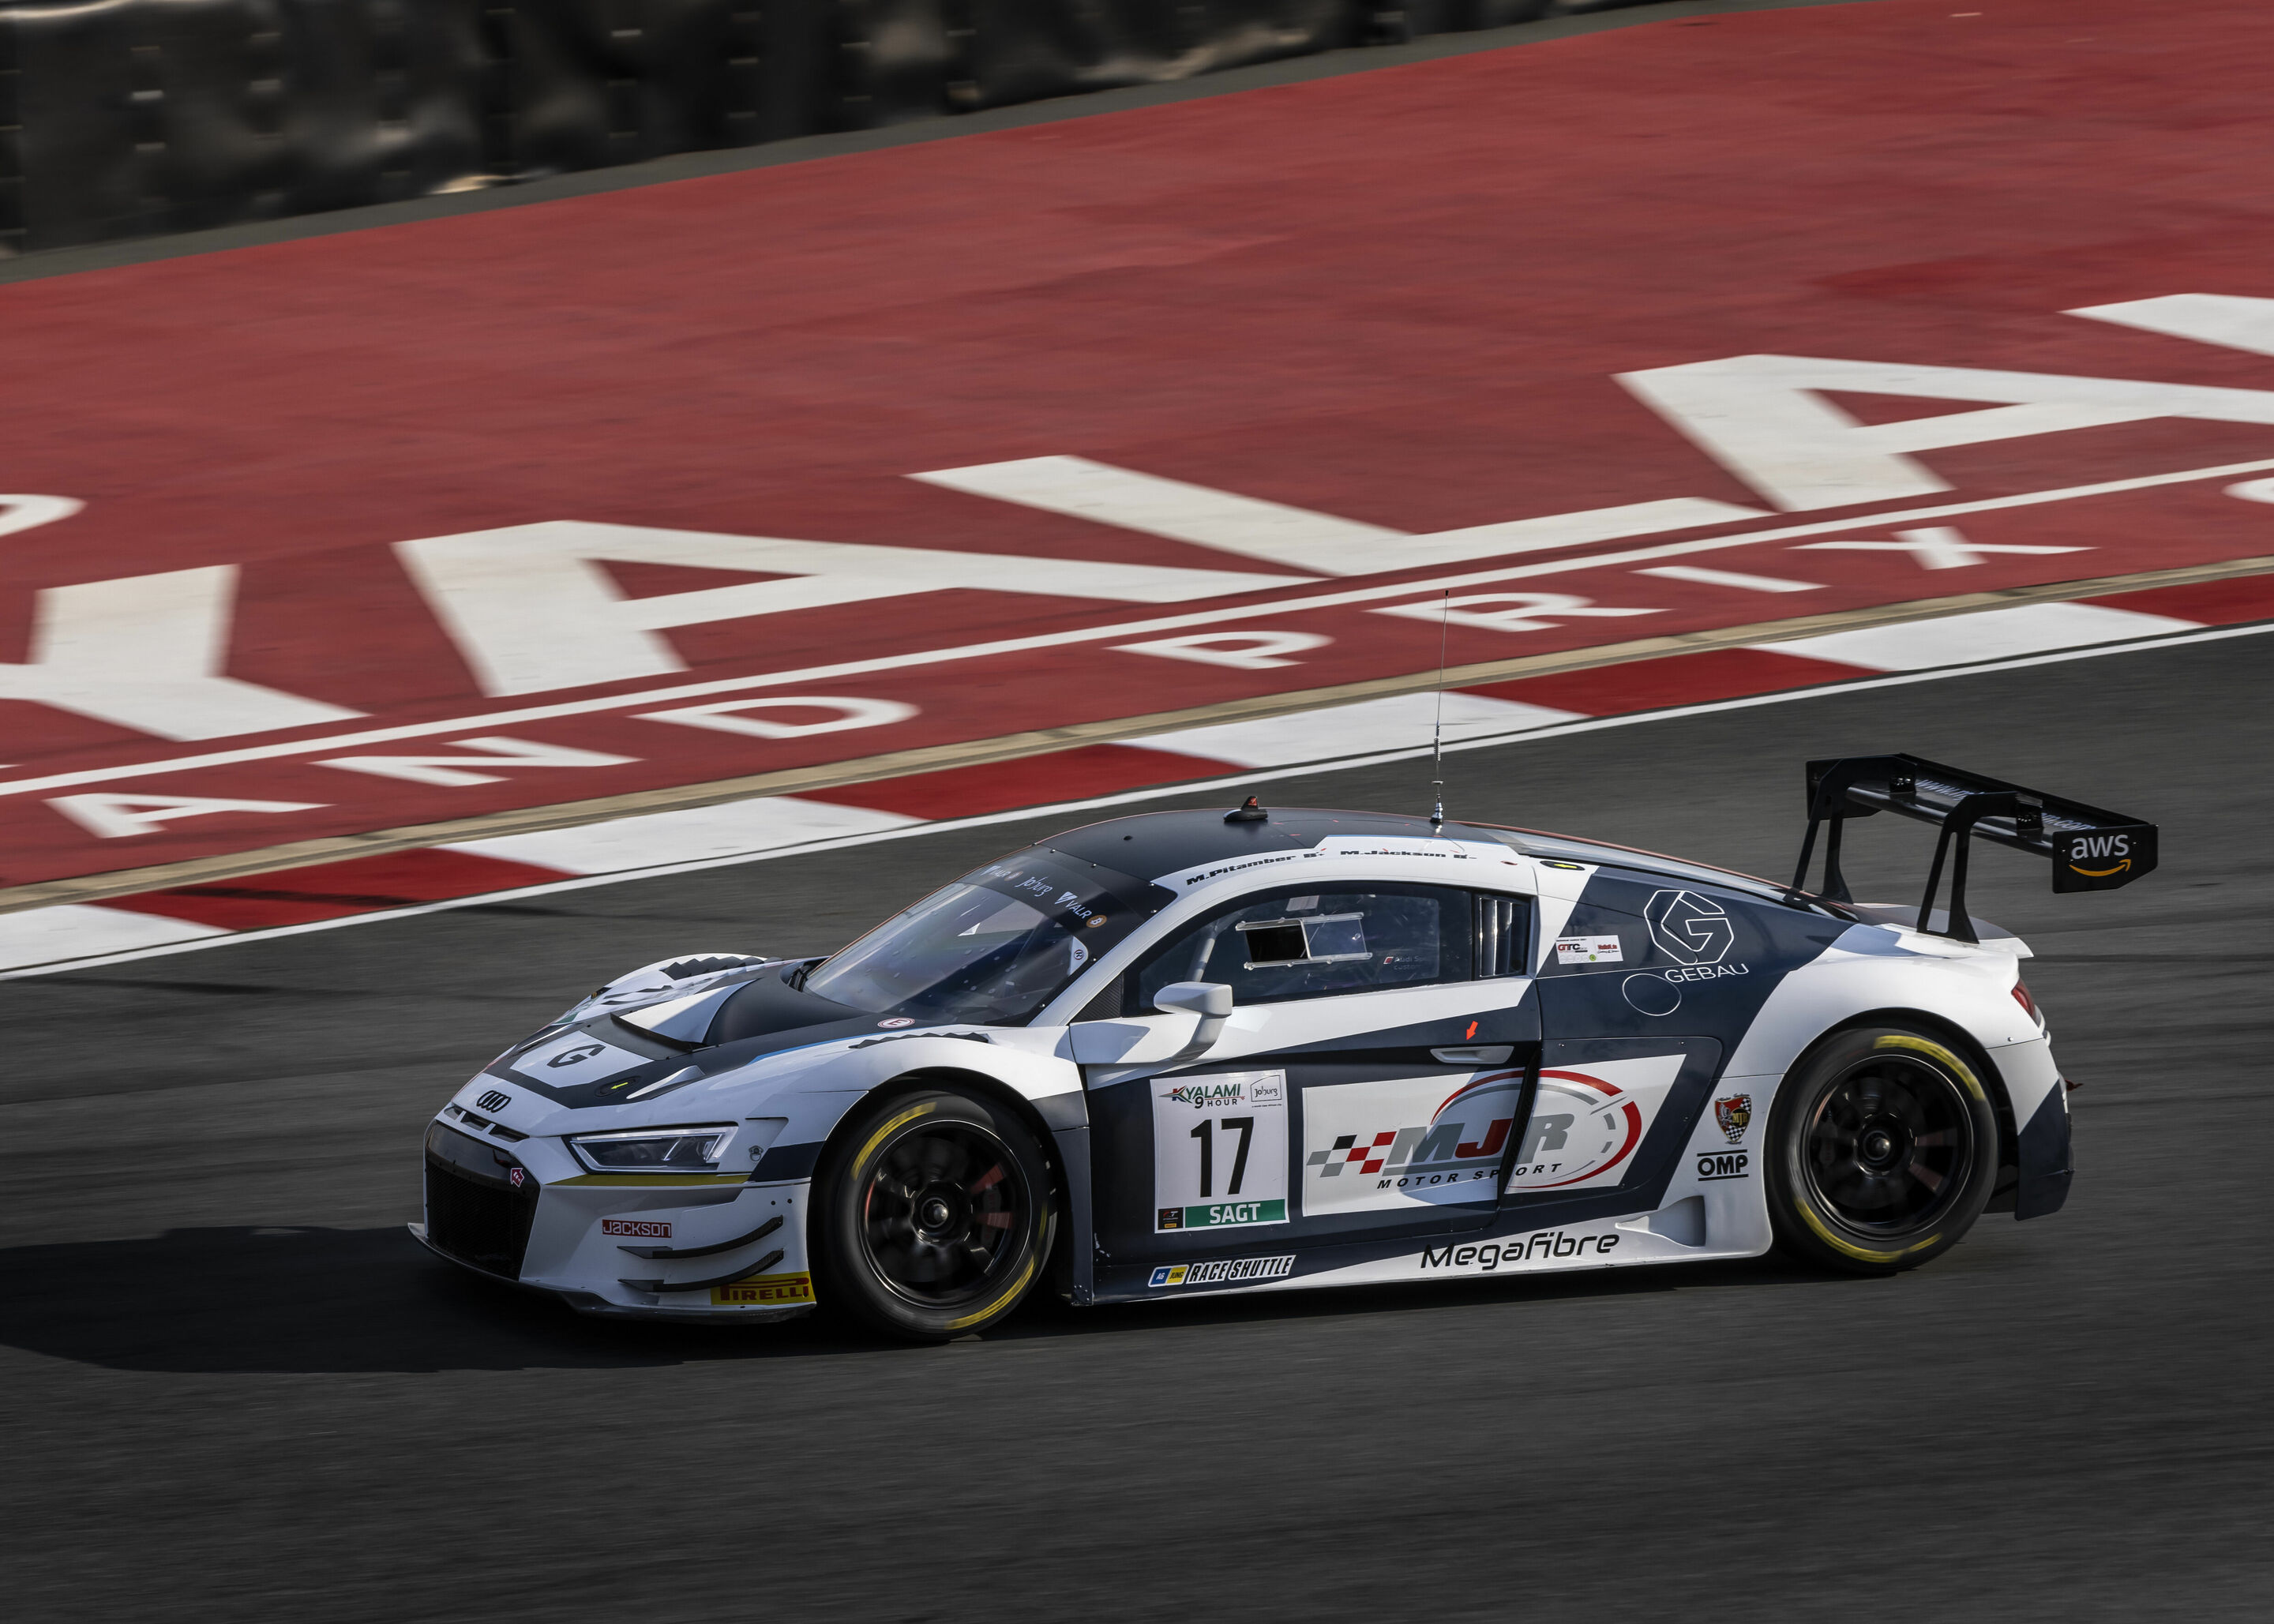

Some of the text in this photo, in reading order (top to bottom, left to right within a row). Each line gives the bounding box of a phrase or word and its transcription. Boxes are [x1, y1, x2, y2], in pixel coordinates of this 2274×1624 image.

[2071, 834, 2130, 860] aws
[1065, 900, 1093, 919] VALR
[1665, 963, 1750, 983] GEBAU
[1195, 1097, 1204, 1109] 9
[1207, 1098, 1238, 1107] HOUR
[1385, 1113, 1575, 1166] MJR
[1191, 1116, 1254, 1198] 17
[1698, 1154, 1748, 1176] OMP
[1376, 1172, 1459, 1190] MOTOR
[1210, 1202, 1261, 1224] SAGT
[1420, 1231, 1620, 1270] Megafibre
[1188, 1257, 1293, 1282] RACE SHUTTLE
[720, 1277, 810, 1301] PIRELLI
